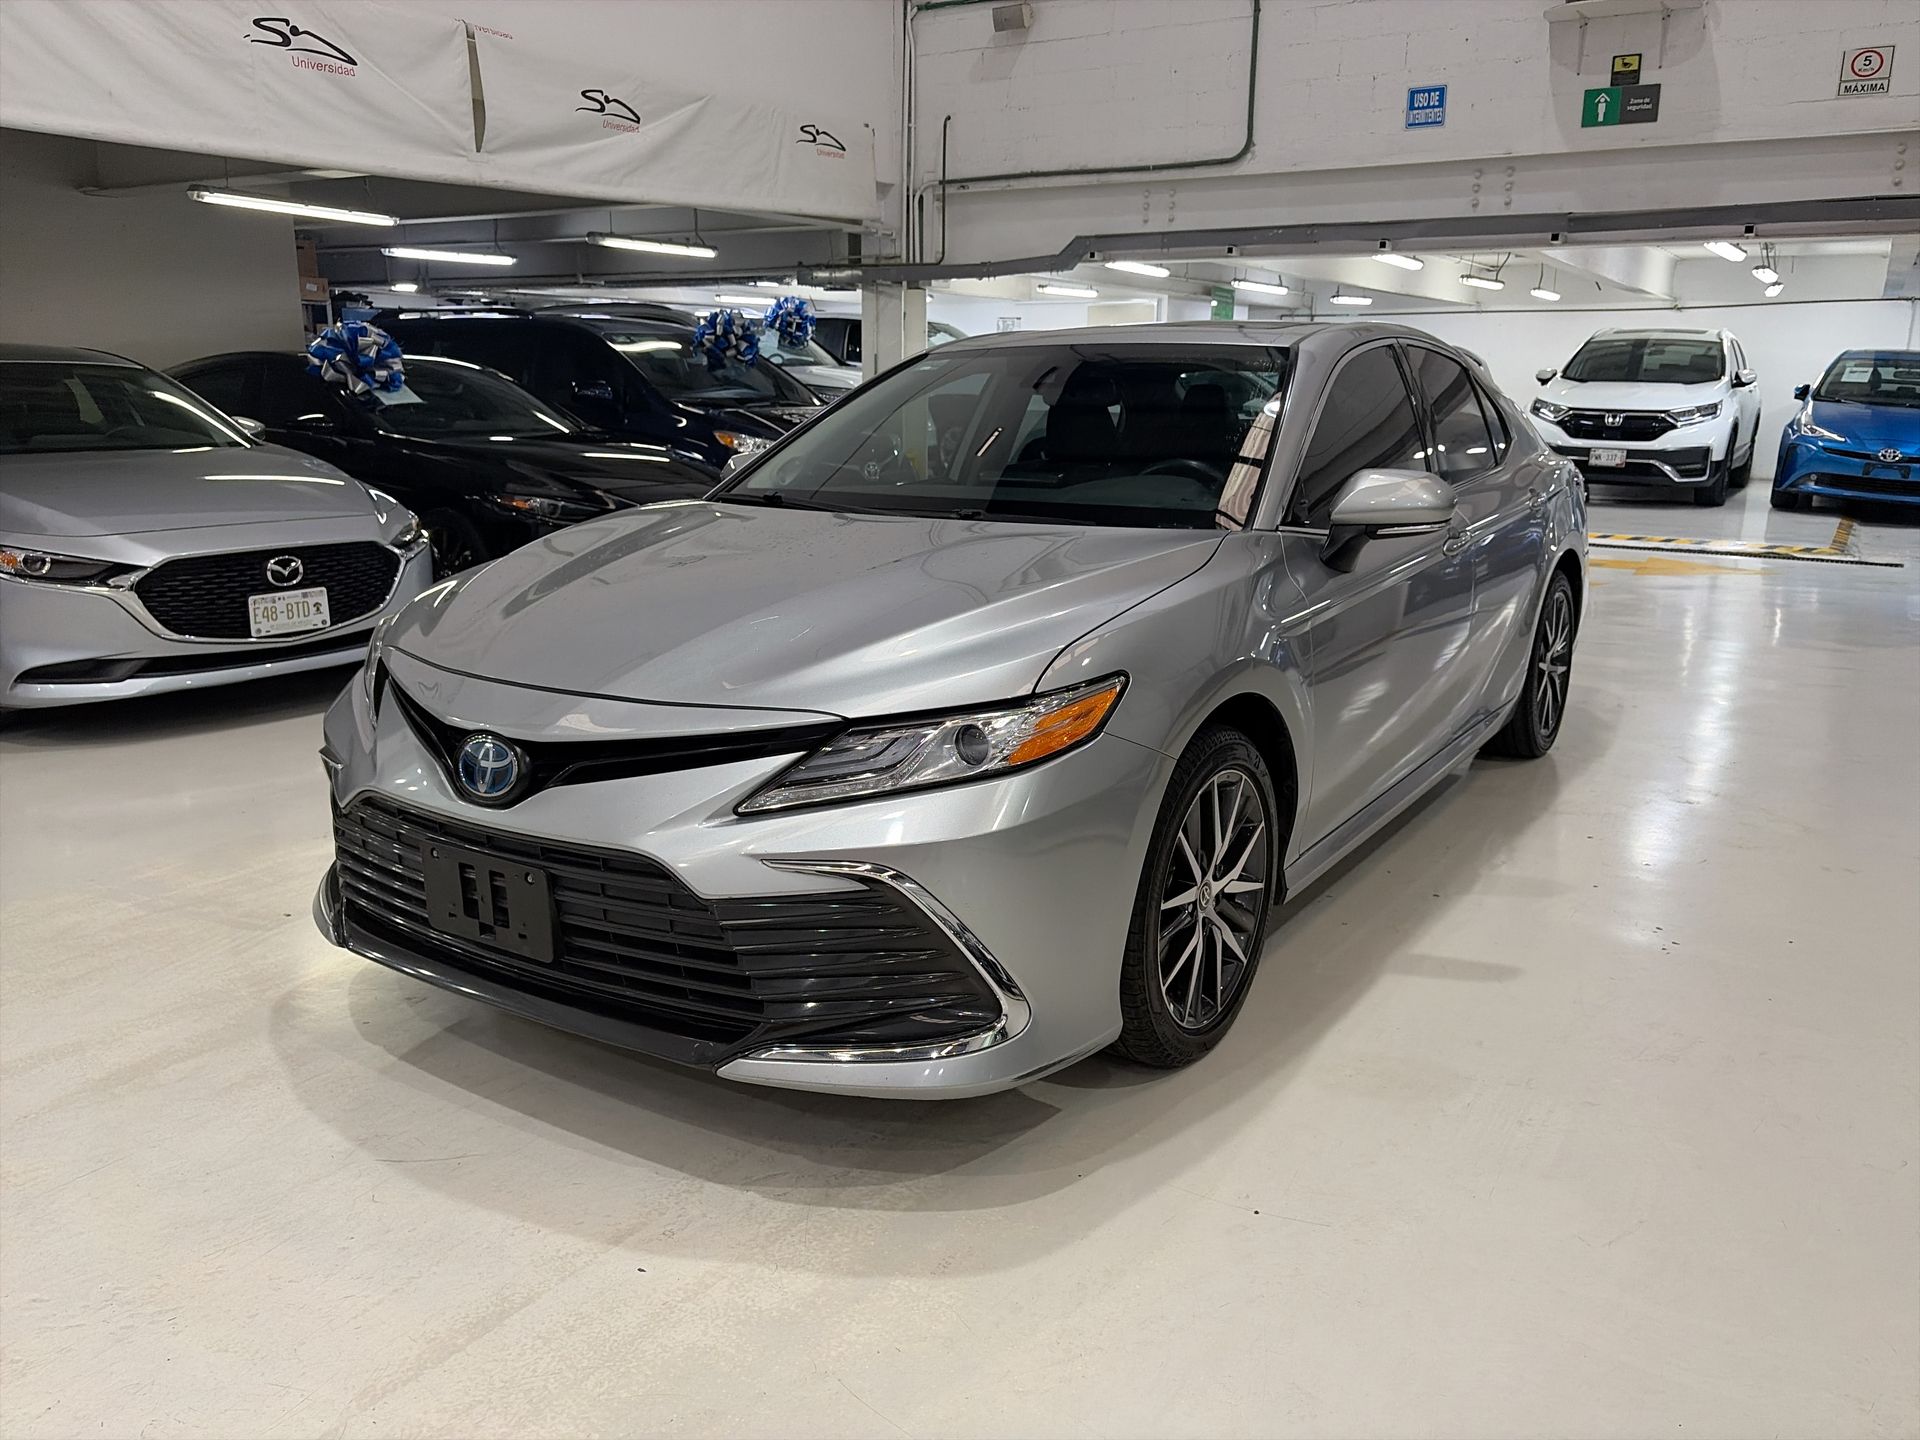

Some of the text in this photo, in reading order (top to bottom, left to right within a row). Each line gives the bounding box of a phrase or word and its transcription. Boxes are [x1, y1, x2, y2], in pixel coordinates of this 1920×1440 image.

[291, 55, 356, 77] Universidad
[1863, 55, 1873, 67] 5
[1843, 82, 1885, 94] MÁXIMA
[1414, 91, 1440, 108] USO DE
[602, 118, 641, 134] Universidad
[253, 600, 311, 625] E48-BTD
